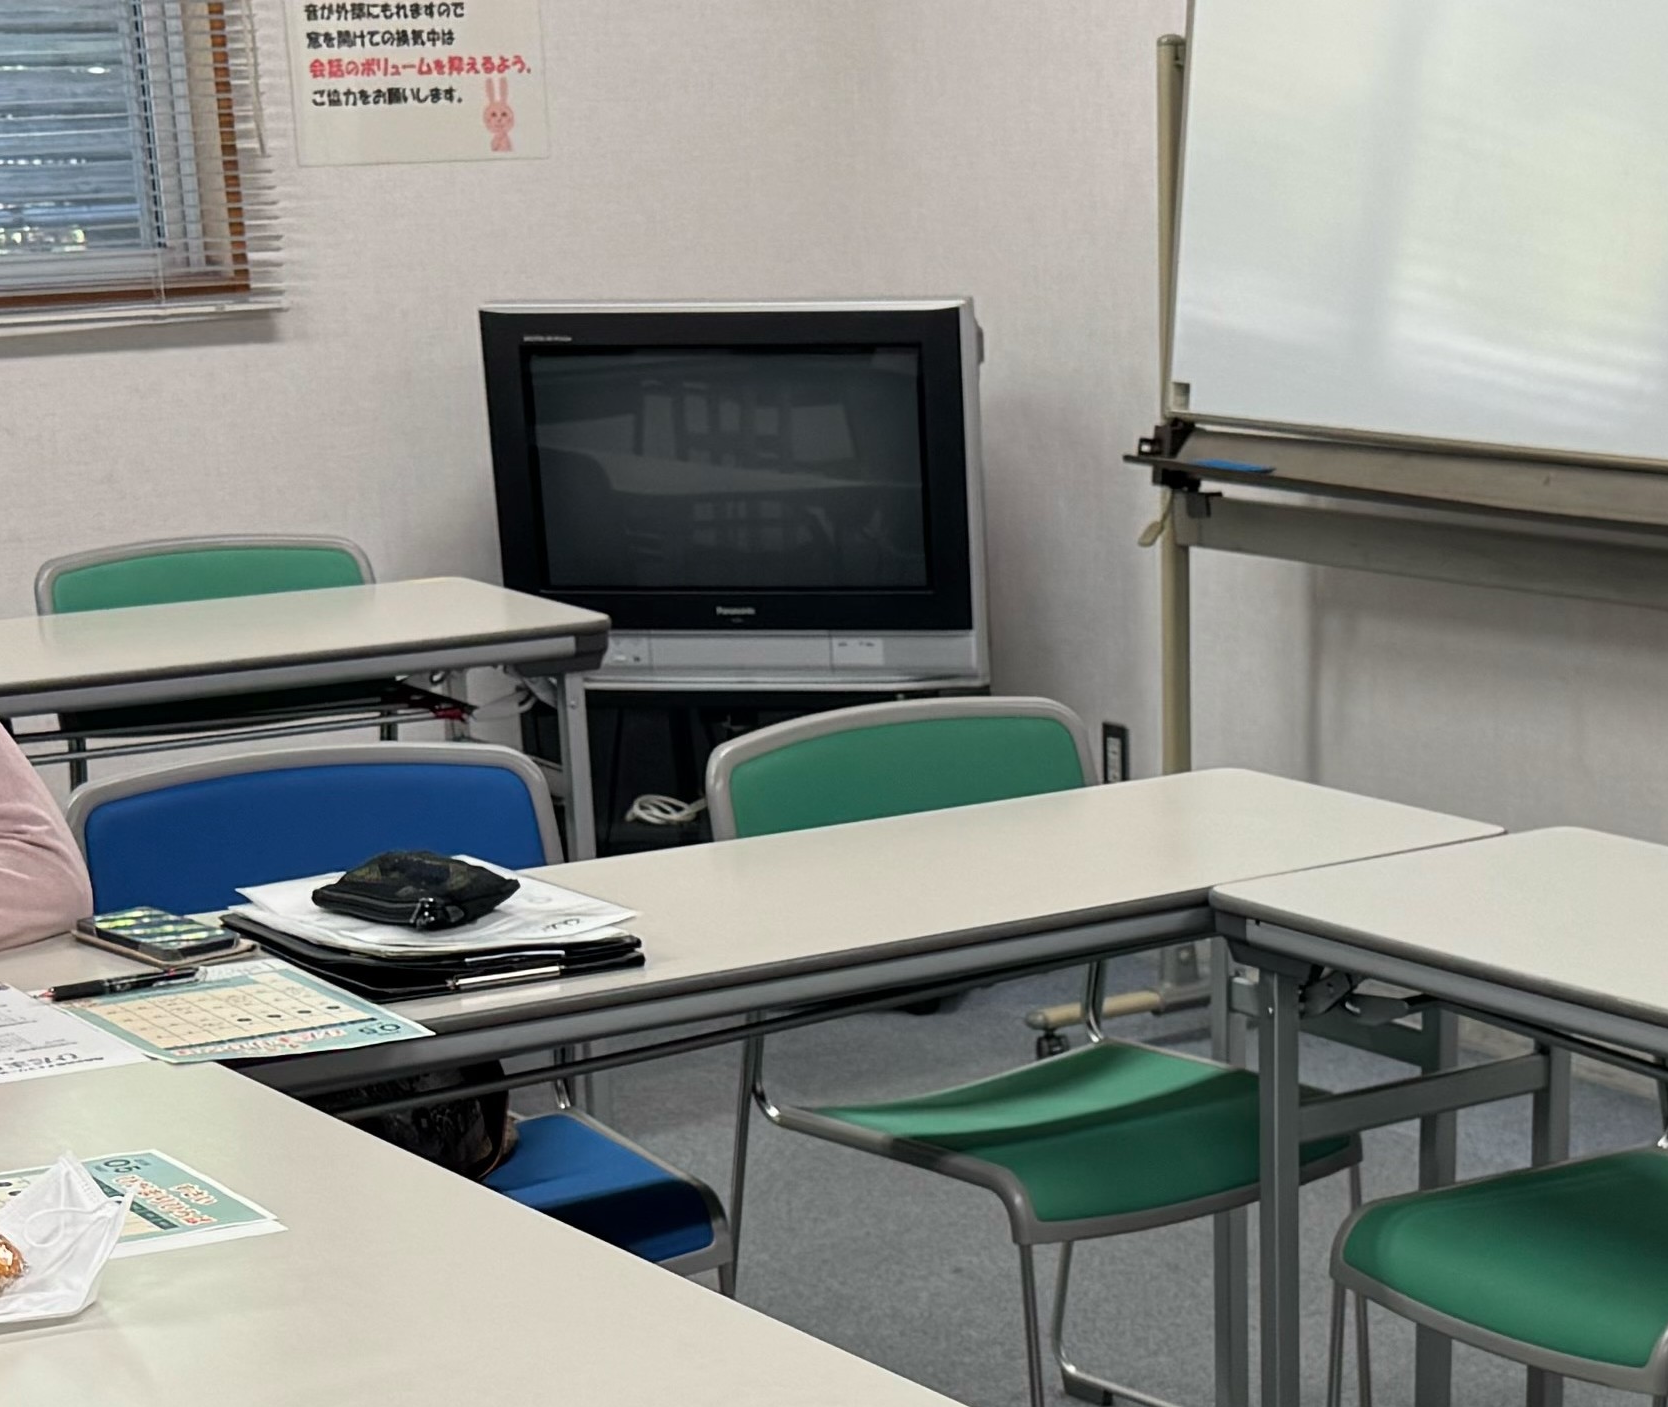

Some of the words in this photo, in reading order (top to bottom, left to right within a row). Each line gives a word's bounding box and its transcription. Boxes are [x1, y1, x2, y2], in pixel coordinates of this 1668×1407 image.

[305, 2, 464, 21] 音が外部にもれますので
[306, 29, 455, 49] 窓を開けての換気中は
